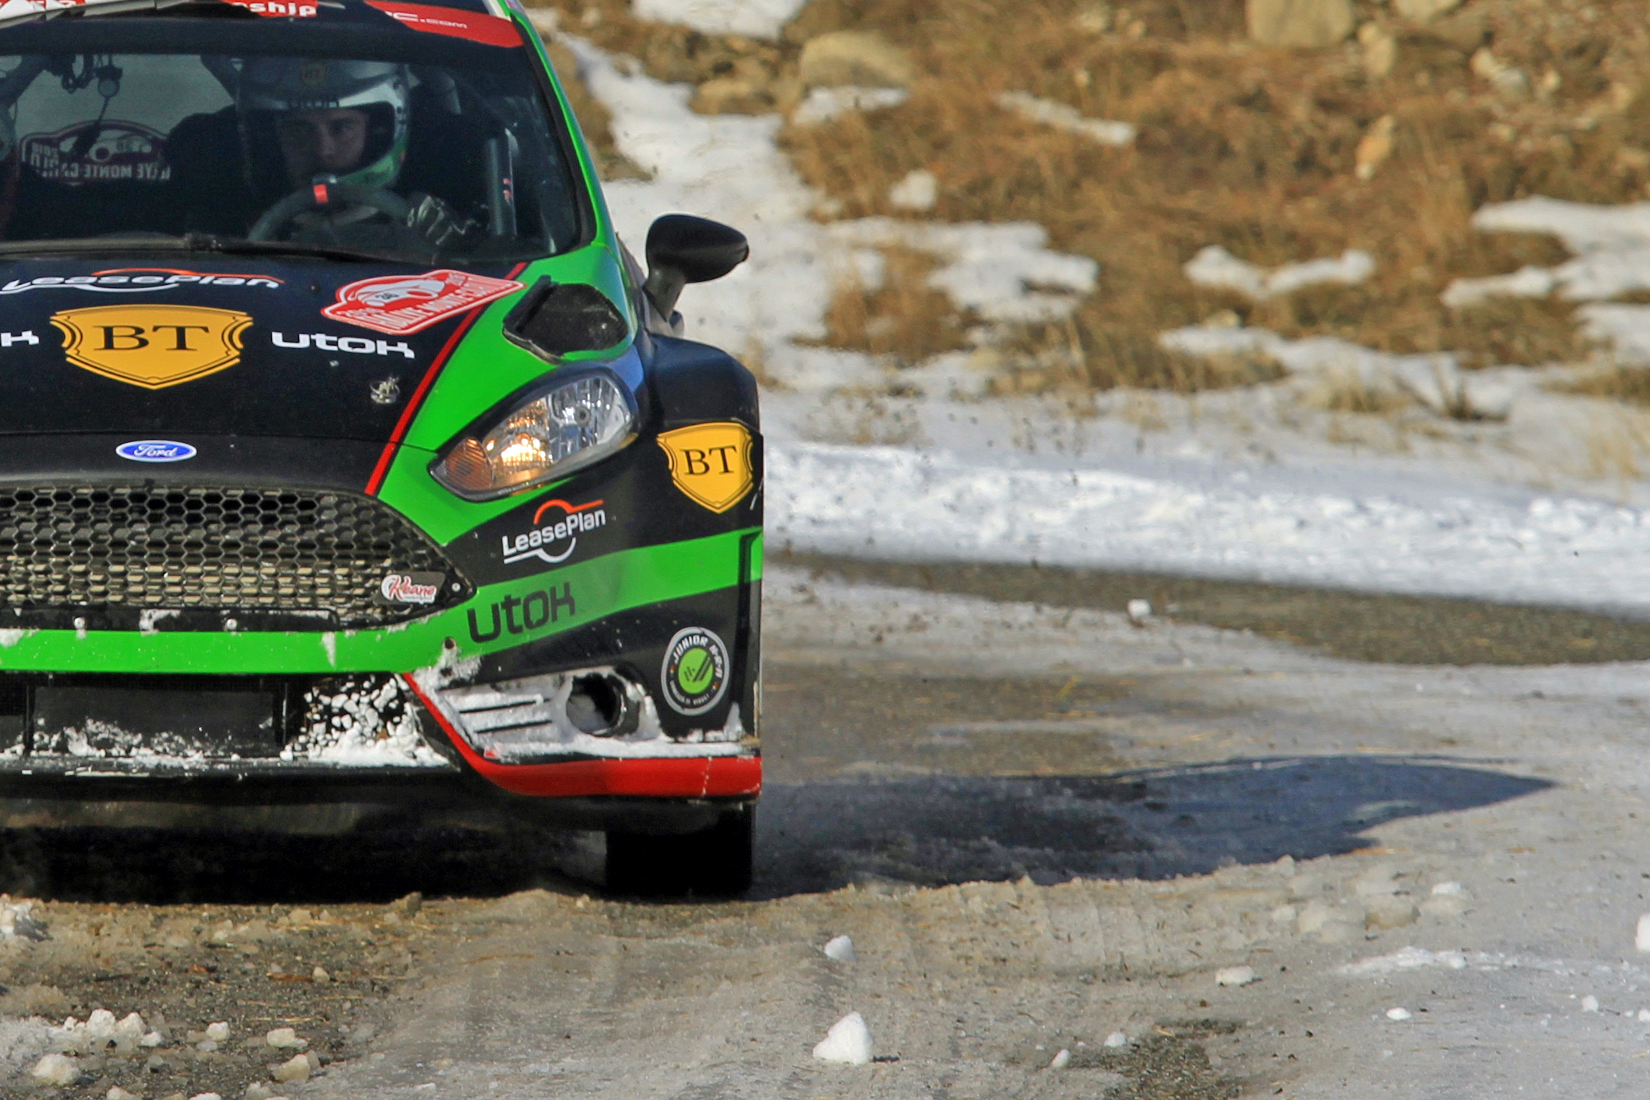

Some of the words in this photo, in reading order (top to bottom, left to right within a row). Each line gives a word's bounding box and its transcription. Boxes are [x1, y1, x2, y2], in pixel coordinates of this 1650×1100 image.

[2, 275, 279, 291] LeasePlan
[93, 325, 209, 351] BT
[133, 444, 179, 457] Ford
[679, 445, 738, 476] BT
[501, 509, 606, 557] LeasePlan
[673, 635, 709, 665] JUNIOR
